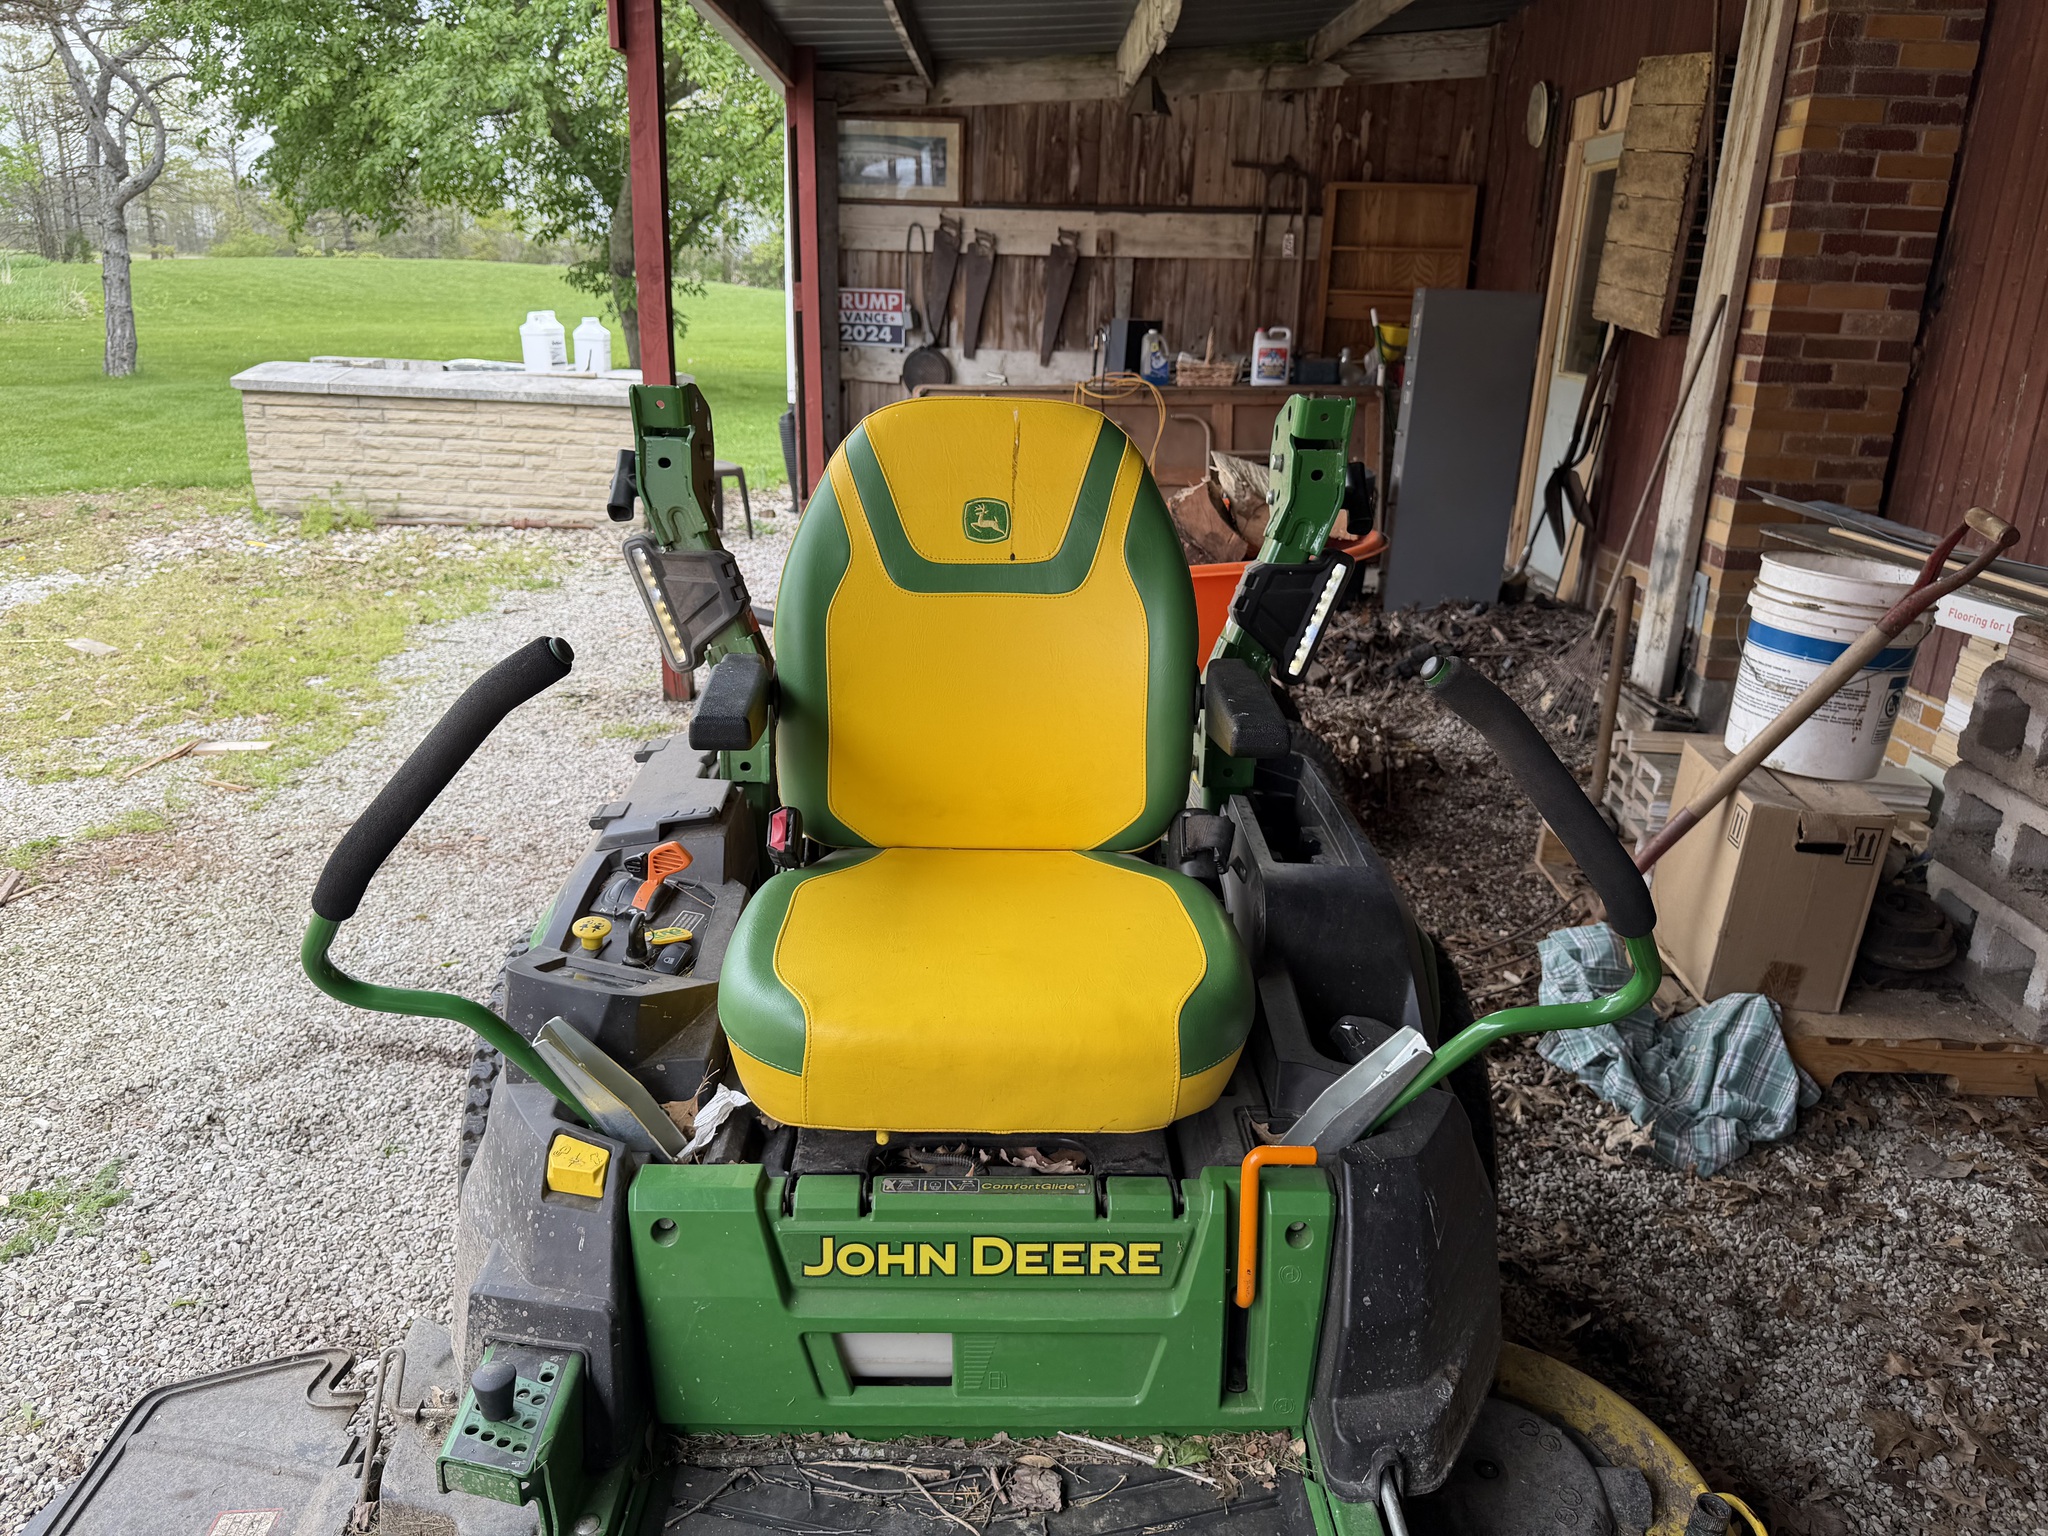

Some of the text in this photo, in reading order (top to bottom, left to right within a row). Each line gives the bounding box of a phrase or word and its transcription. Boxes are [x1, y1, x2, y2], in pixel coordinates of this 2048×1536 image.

[840, 293, 900, 311] RUMP
[843, 312, 889, 323] VANCE
[840, 325, 893, 342] 2024
[1948, 607, 1988, 629] Flooring
[1989, 618, 2005, 631] for
[803, 1235, 1163, 1277] JOHN DEERE
